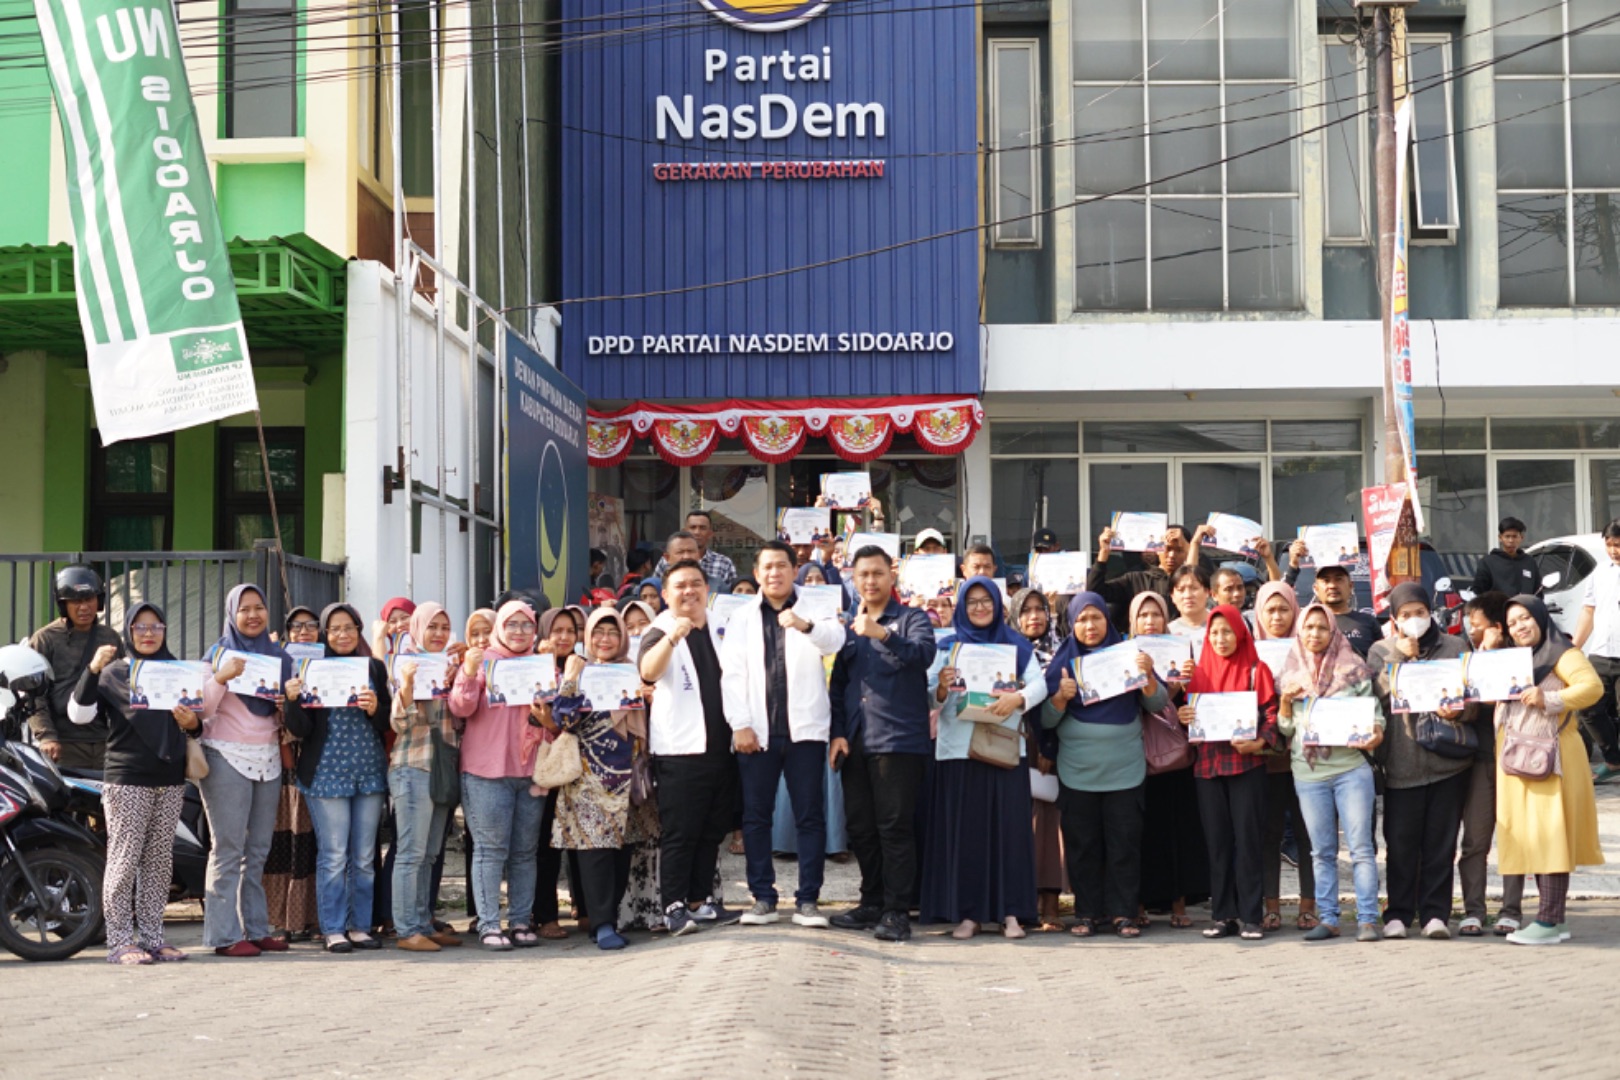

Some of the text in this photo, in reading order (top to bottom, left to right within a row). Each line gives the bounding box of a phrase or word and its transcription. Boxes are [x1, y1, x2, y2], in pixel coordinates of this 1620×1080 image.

[705, 46, 831, 81] Partai
[656, 94, 885, 139] NasDem
[653, 160, 884, 181] GERAKAN PERUBAHAN
[588, 331, 954, 355] DPD PARTAI NASDEM SIDOARJO
